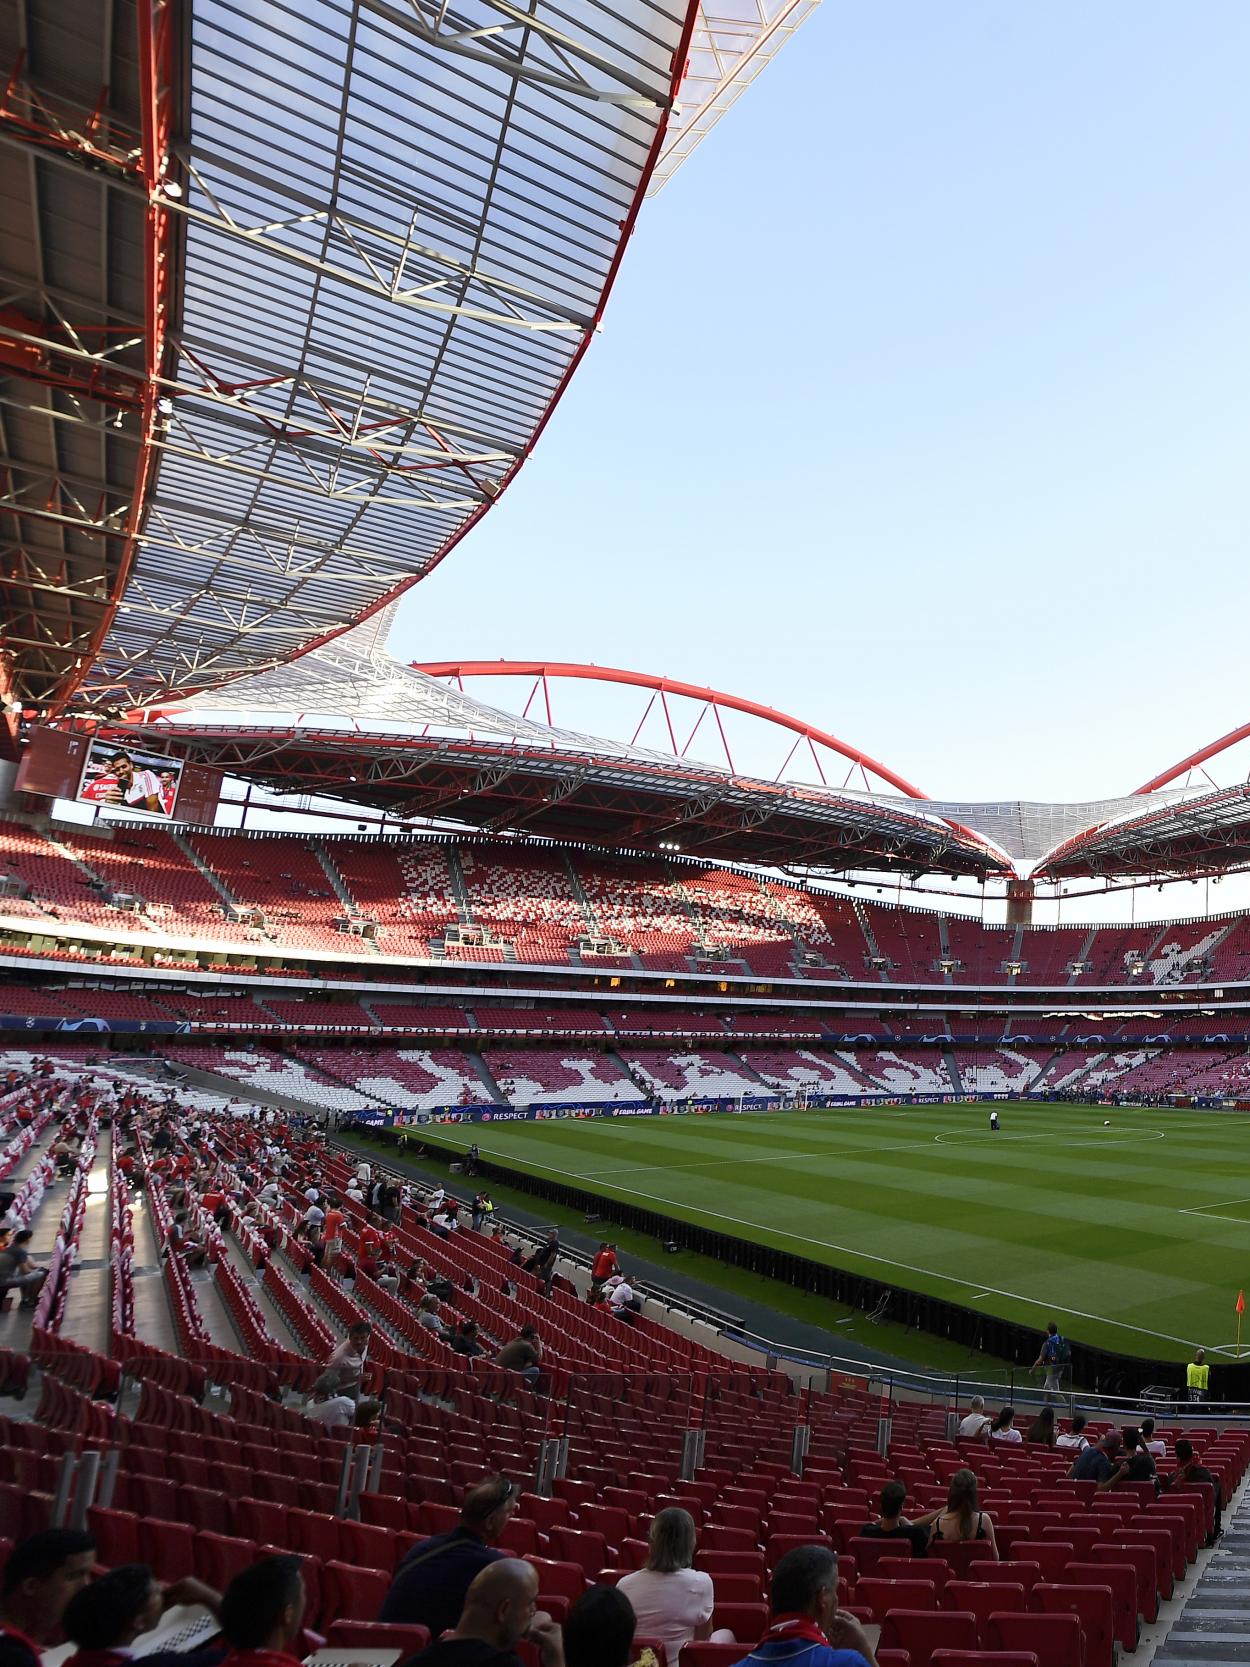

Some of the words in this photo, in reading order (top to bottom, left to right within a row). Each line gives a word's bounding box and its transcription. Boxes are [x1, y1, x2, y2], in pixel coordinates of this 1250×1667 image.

[216, 1023, 306, 1033] PLURIBUS
[391, 1027, 450, 1036] SPORT
[457, 1028, 517, 1037] LISBOA
[542, 1029, 608, 1038] BENFICA
[493, 1112, 528, 1121] RESPECT
